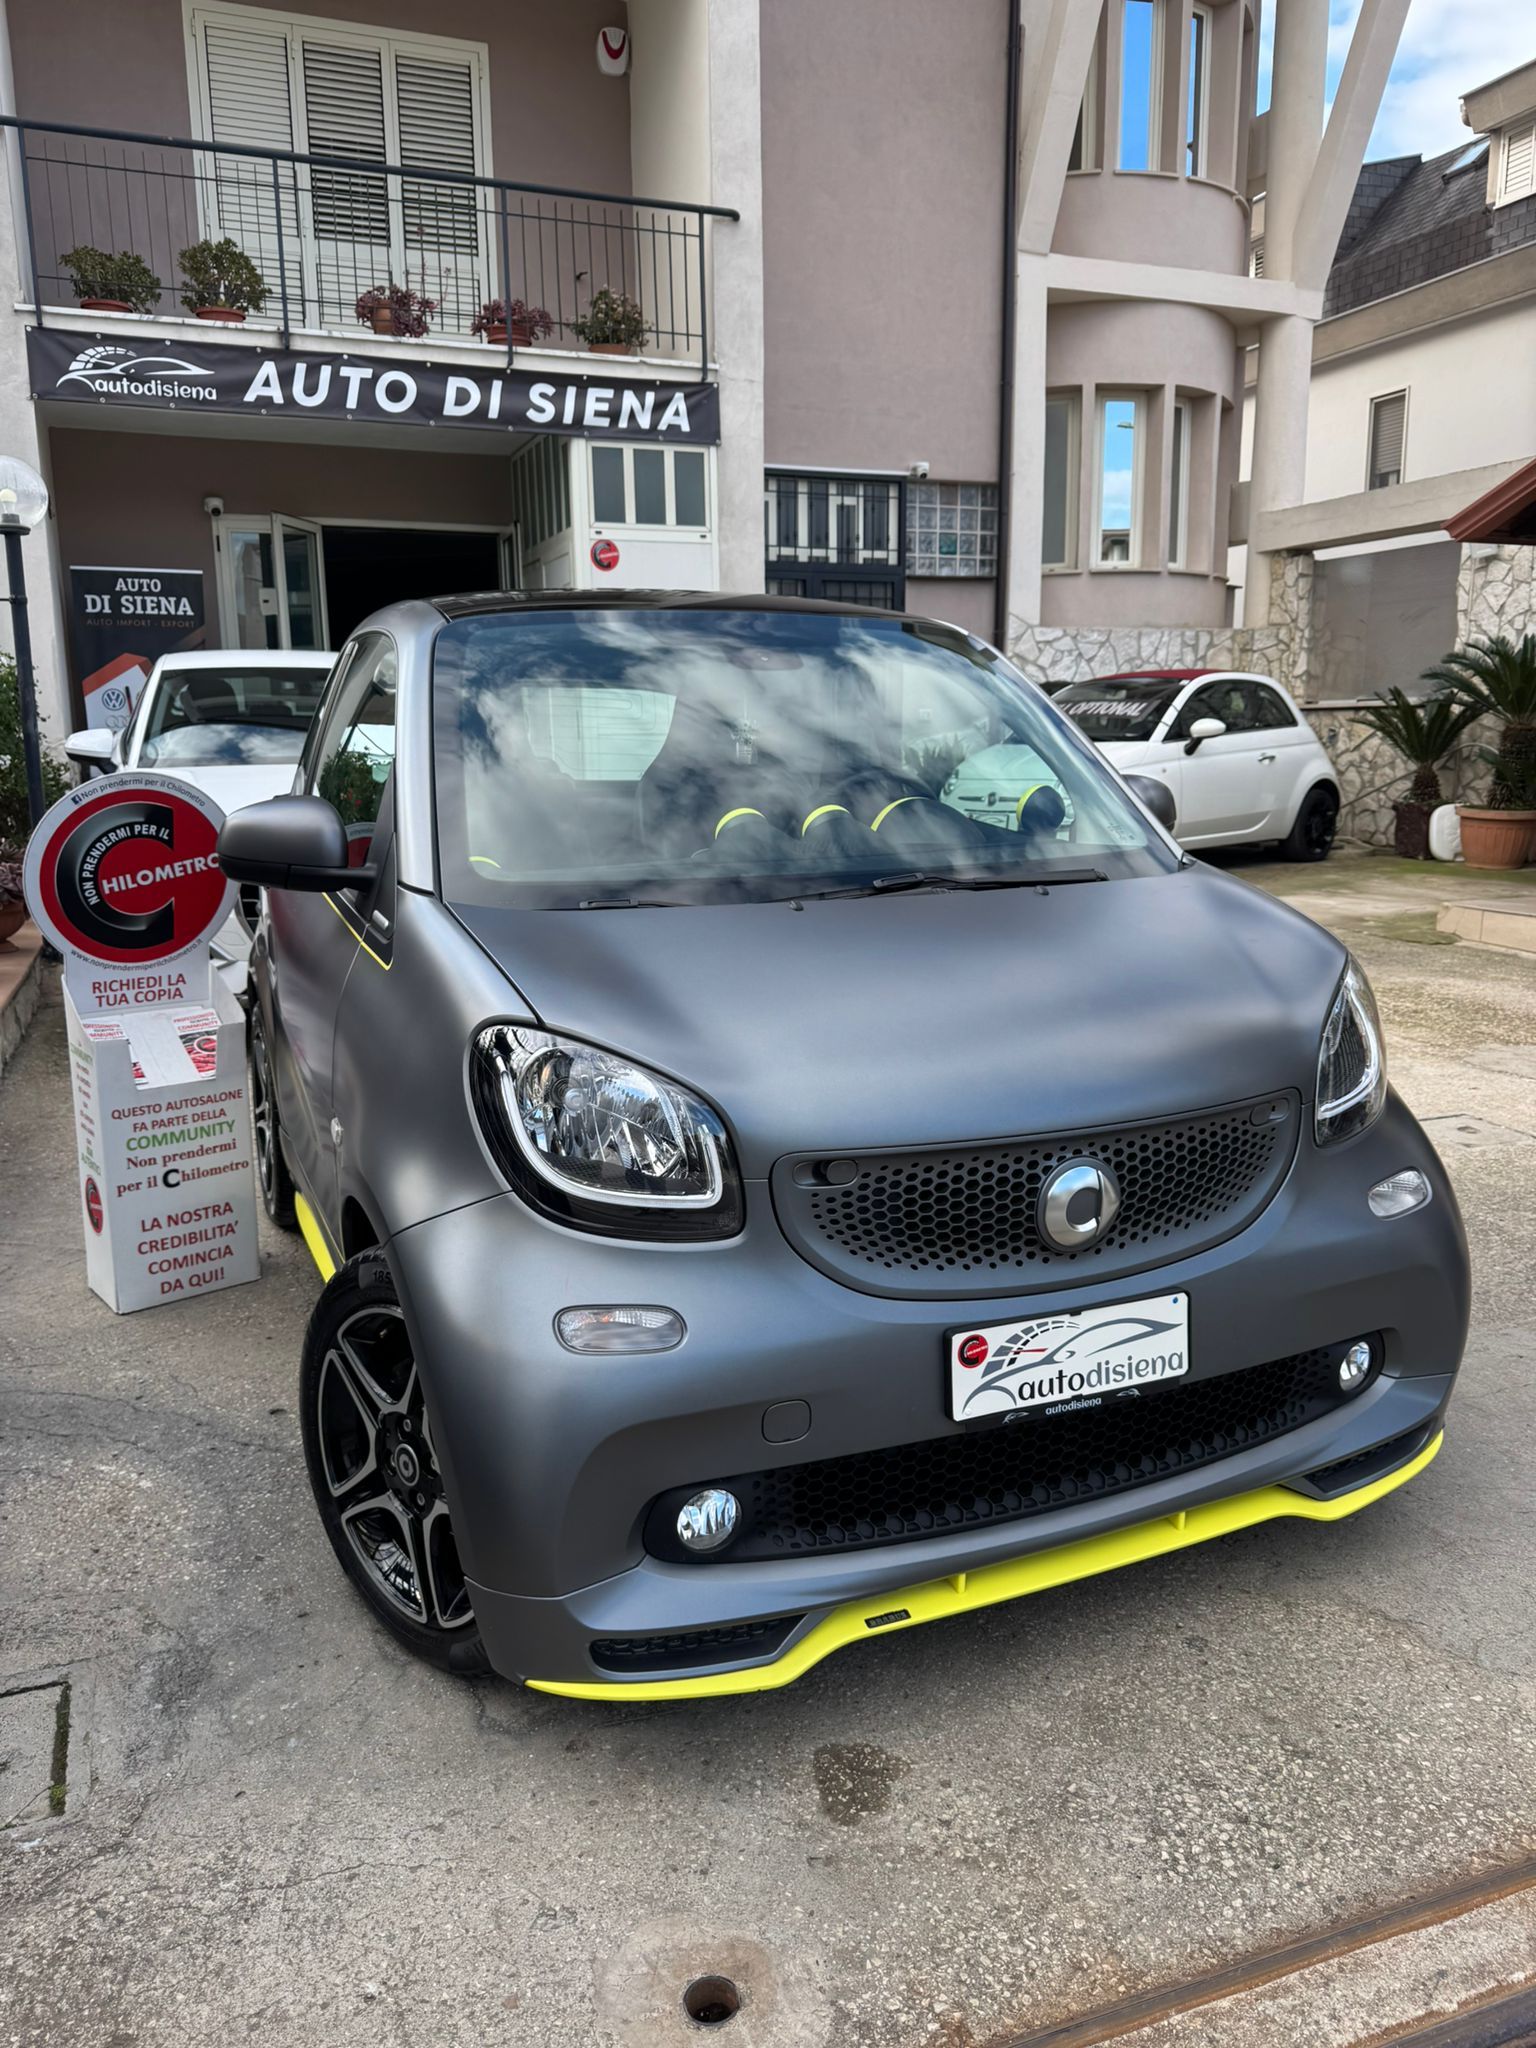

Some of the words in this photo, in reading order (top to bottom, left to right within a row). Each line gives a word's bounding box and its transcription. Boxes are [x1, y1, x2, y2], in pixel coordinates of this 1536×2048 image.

[94, 376, 217, 401] autodisiena
[243, 360, 417, 413] AUTO
[443, 376, 503, 419] DI
[526, 382, 690, 432] SIENA
[115, 578, 161, 592] AUTO
[84, 594, 112, 613] DI
[121, 595, 194, 616] SIENA
[1068, 701, 1148, 716] OPTIONAL
[81, 787, 98, 800] Non
[100, 777, 143, 792] prendermi
[145, 778, 159, 787] per
[159, 779, 166, 787] il
[166, 781, 206, 807] Chilometro
[134, 824, 157, 836] PER
[159, 827, 170, 840] IL
[82, 826, 131, 878] PRENDERMI
[82, 881, 100, 905] NON
[92, 975, 162, 994] RICHIEDI
[167, 973, 187, 986] LA
[95, 993, 130, 1007] TUA
[134, 987, 184, 1004] COPIA
[111, 1103, 162, 1120] QUESTO
[165, 1089, 244, 1112] AUTOSALONE
[133, 1122, 149, 1133] FA
[151, 1115, 188, 1130] PARTE
[191, 1108, 227, 1123] DELLA
[126, 1120, 236, 1151] COMMUNITY
[126, 1156, 157, 1170] Non
[162, 1138, 237, 1167] prendermi
[117, 1181, 142, 1197] per
[147, 1175, 158, 1188] il
[162, 1160, 249, 1188] Chilometro
[141, 1217, 162, 1233] LA
[167, 1201, 234, 1227] NOSTRA
[137, 1220, 239, 1255] CREDIBILITA'
[148, 1244, 234, 1275] COMINCIA
[160, 1278, 184, 1294] DA
[188, 1267, 225, 1288] QUI!
[1018, 1351, 1184, 1401] autodisiena
[1045, 1396, 1102, 1416] autodisiena
